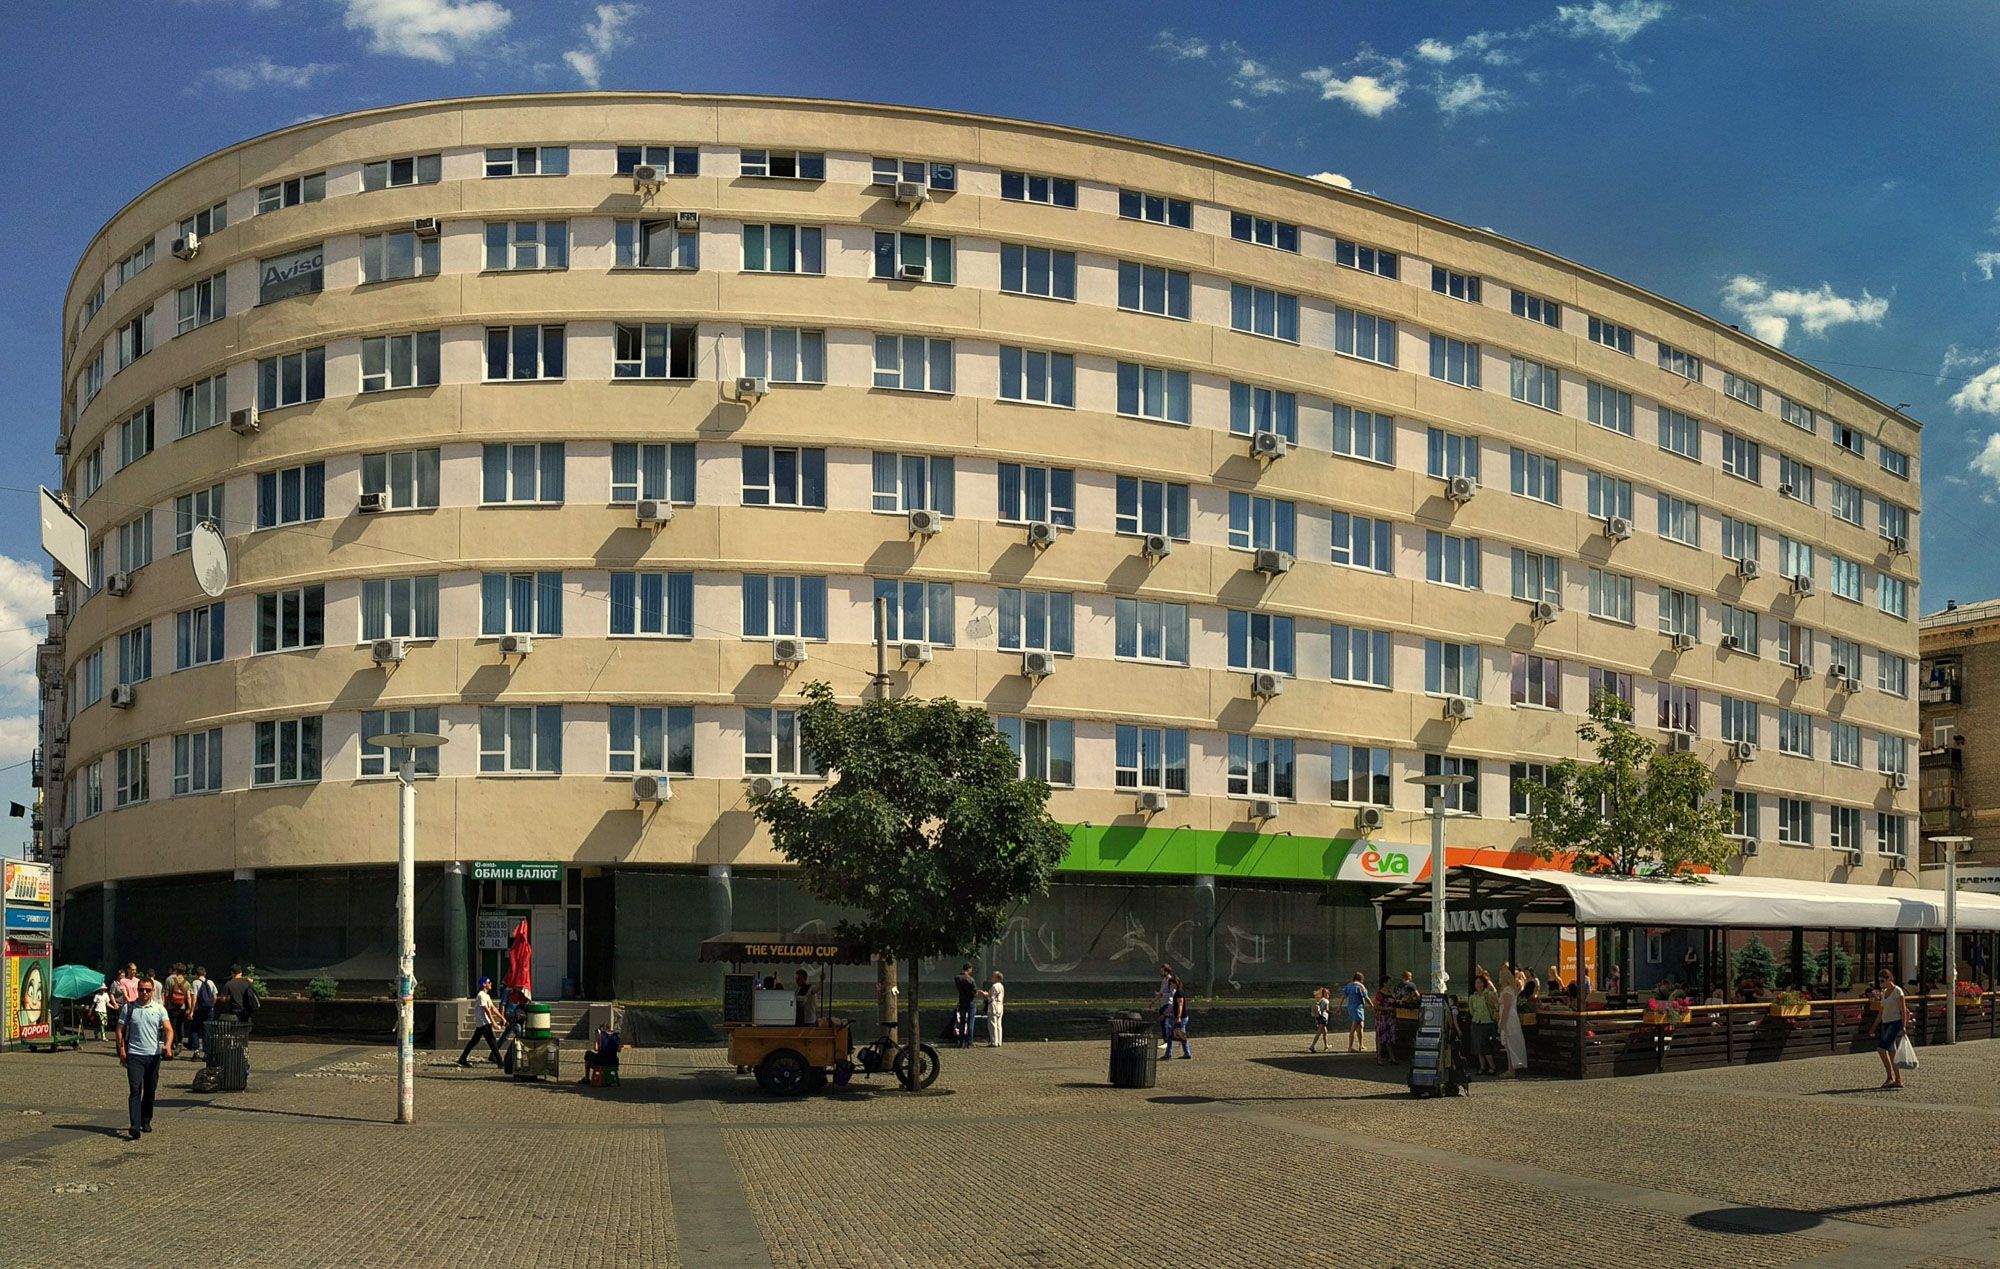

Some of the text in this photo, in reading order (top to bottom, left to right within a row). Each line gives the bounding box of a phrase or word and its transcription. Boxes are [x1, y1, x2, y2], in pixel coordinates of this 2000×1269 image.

[1361, 851, 1409, 874] eva
[474, 868, 558, 879] ОБМІН ВАЛЮТ
[745, 944, 839, 957] THE YELLOW CUP
[21, 1023, 49, 1038] ДОРОГО
